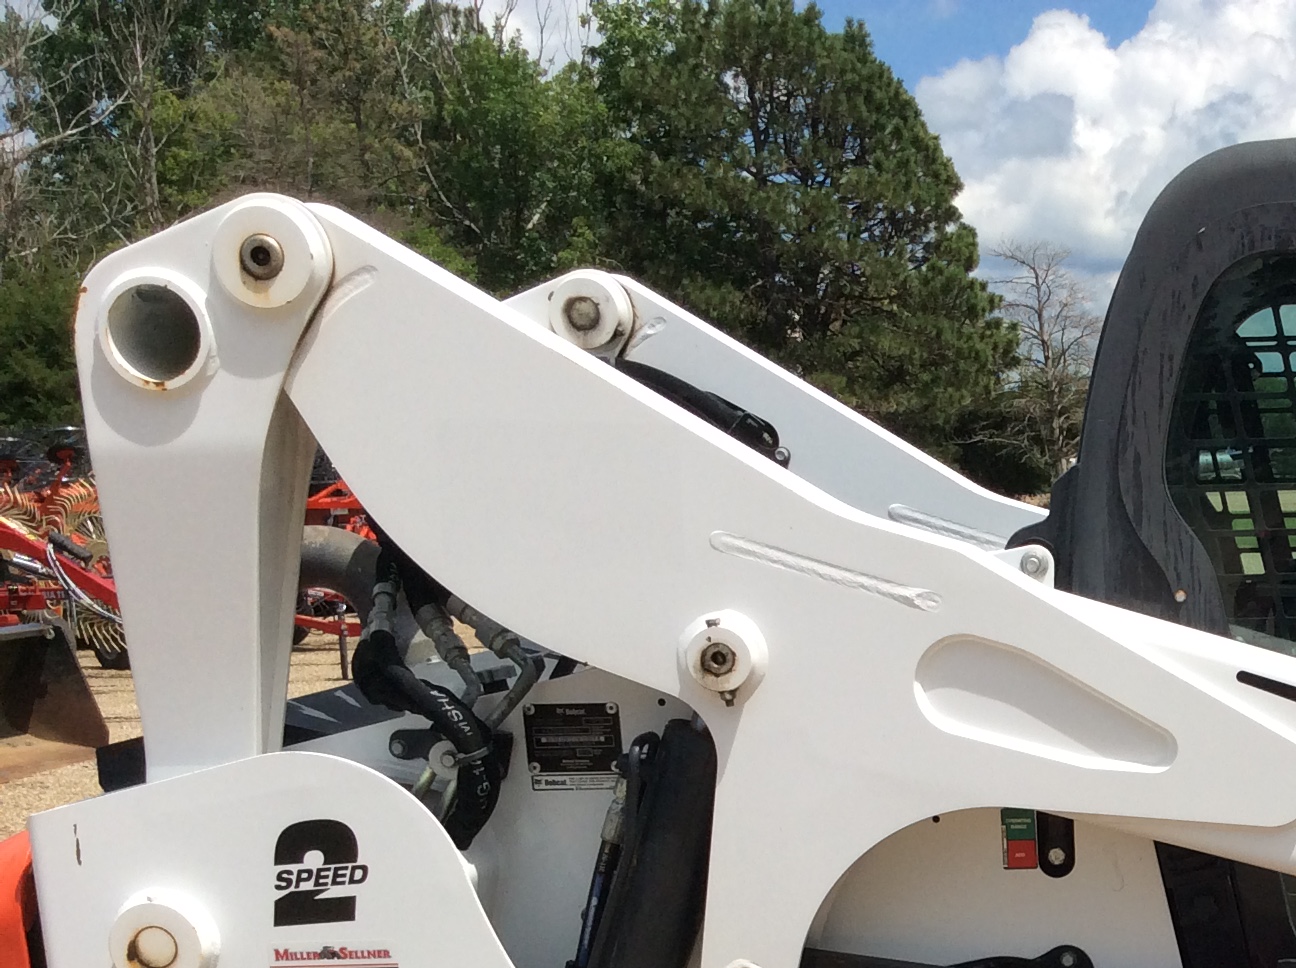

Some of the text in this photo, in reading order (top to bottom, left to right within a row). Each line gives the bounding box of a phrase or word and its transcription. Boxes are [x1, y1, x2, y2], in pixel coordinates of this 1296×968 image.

[544, 779, 568, 787] Bobcat
[273, 819, 359, 927] 2
[274, 864, 369, 891] SPEED
